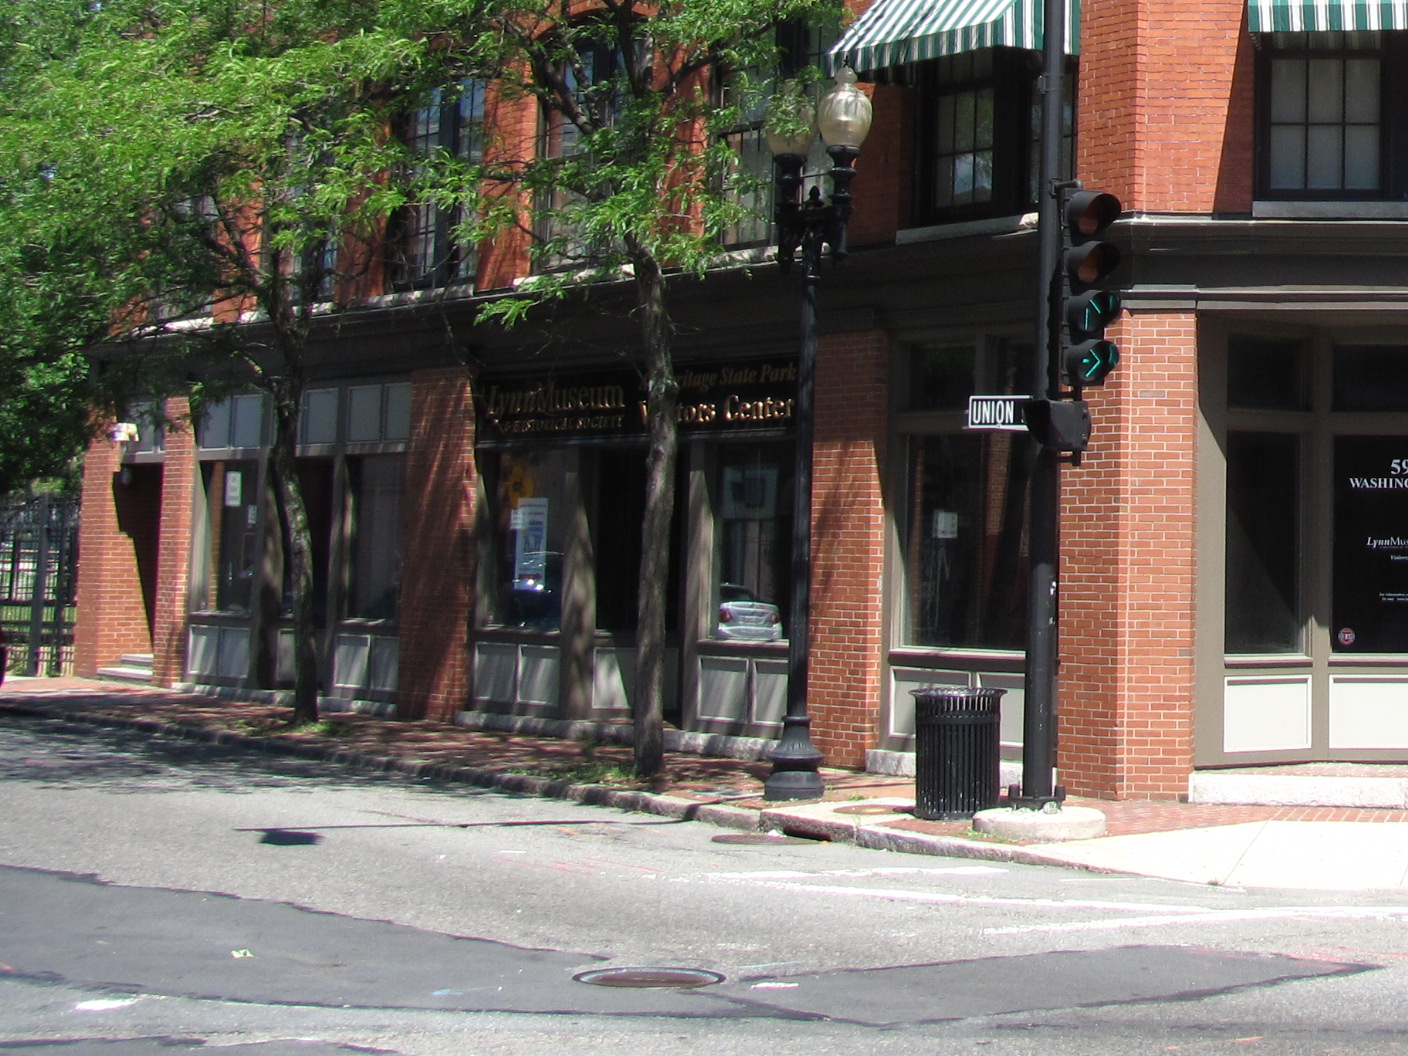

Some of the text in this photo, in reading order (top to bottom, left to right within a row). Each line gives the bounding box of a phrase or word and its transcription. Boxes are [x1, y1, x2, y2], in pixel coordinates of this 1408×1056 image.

[719, 366, 757, 385] State
[759, 362, 797, 383] Park
[723, 394, 795, 421] Center
[972, 400, 1014, 424] UNION
